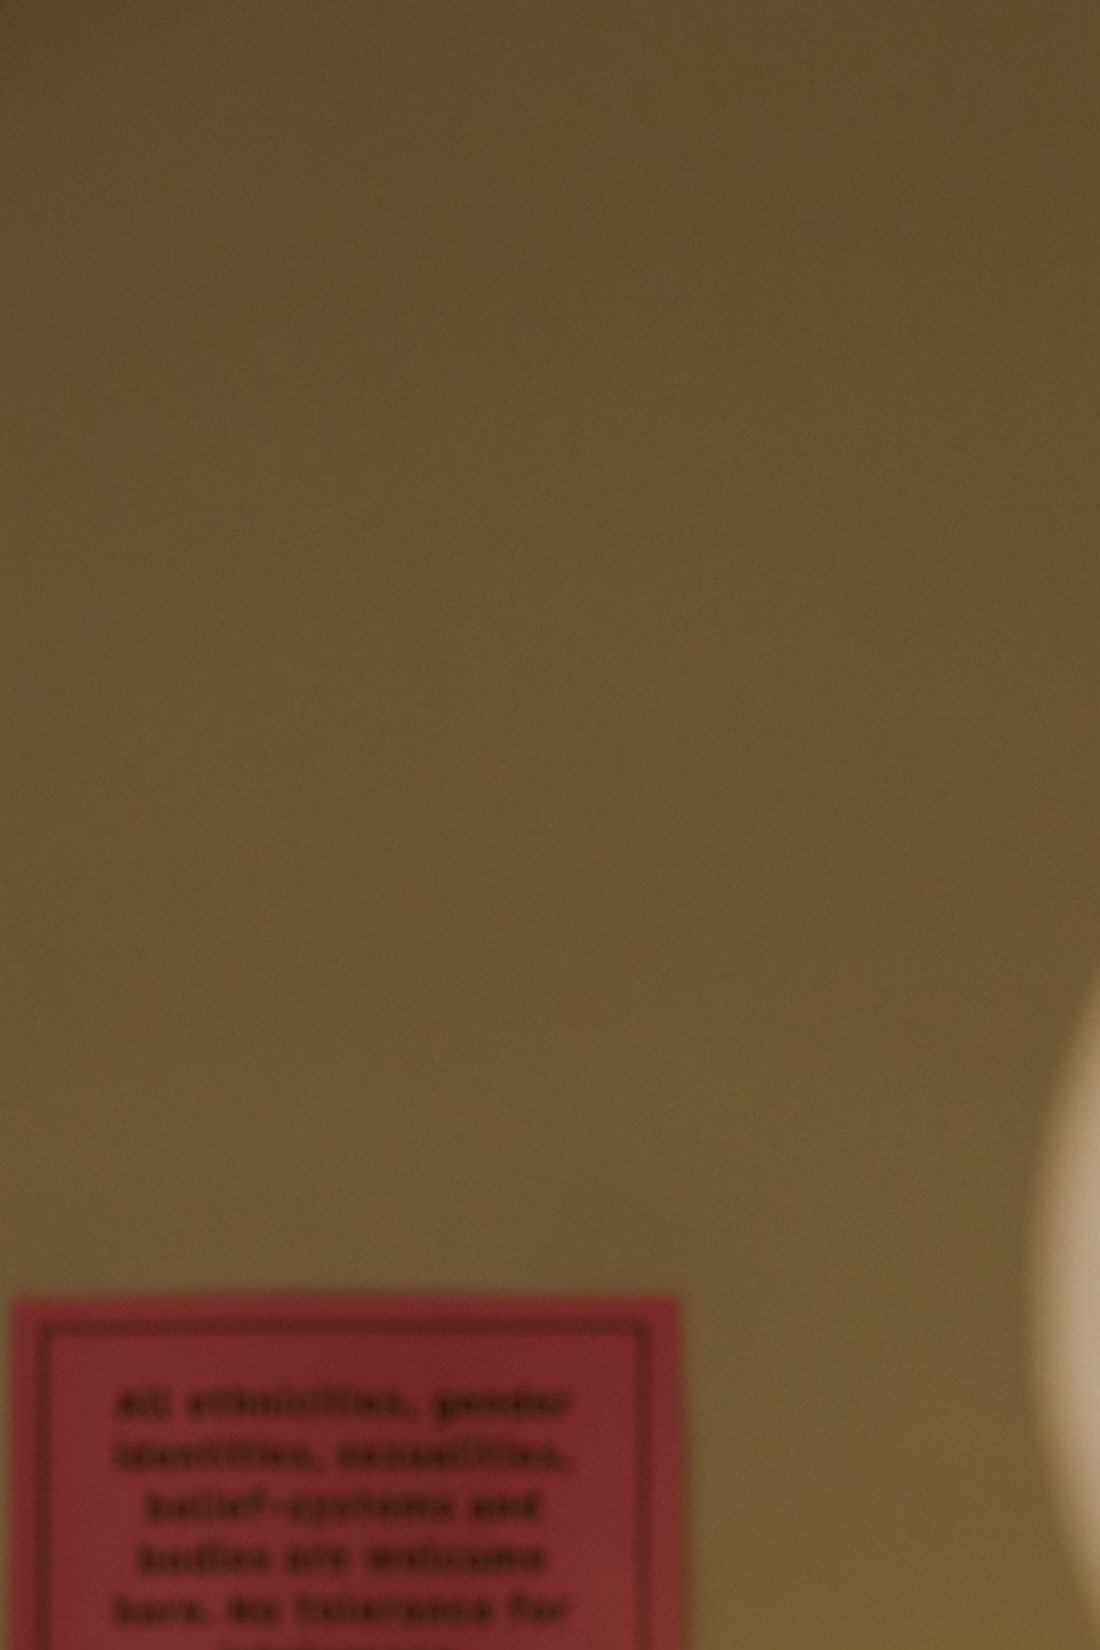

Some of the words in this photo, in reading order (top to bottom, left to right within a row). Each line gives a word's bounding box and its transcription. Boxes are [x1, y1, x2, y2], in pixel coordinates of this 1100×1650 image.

[470, 1489, 541, 1520] and
[285, 1545, 346, 1572] are
[367, 1541, 547, 1572] welcome
[295, 1595, 492, 1625] tolerance
[507, 1593, 573, 1625] for
